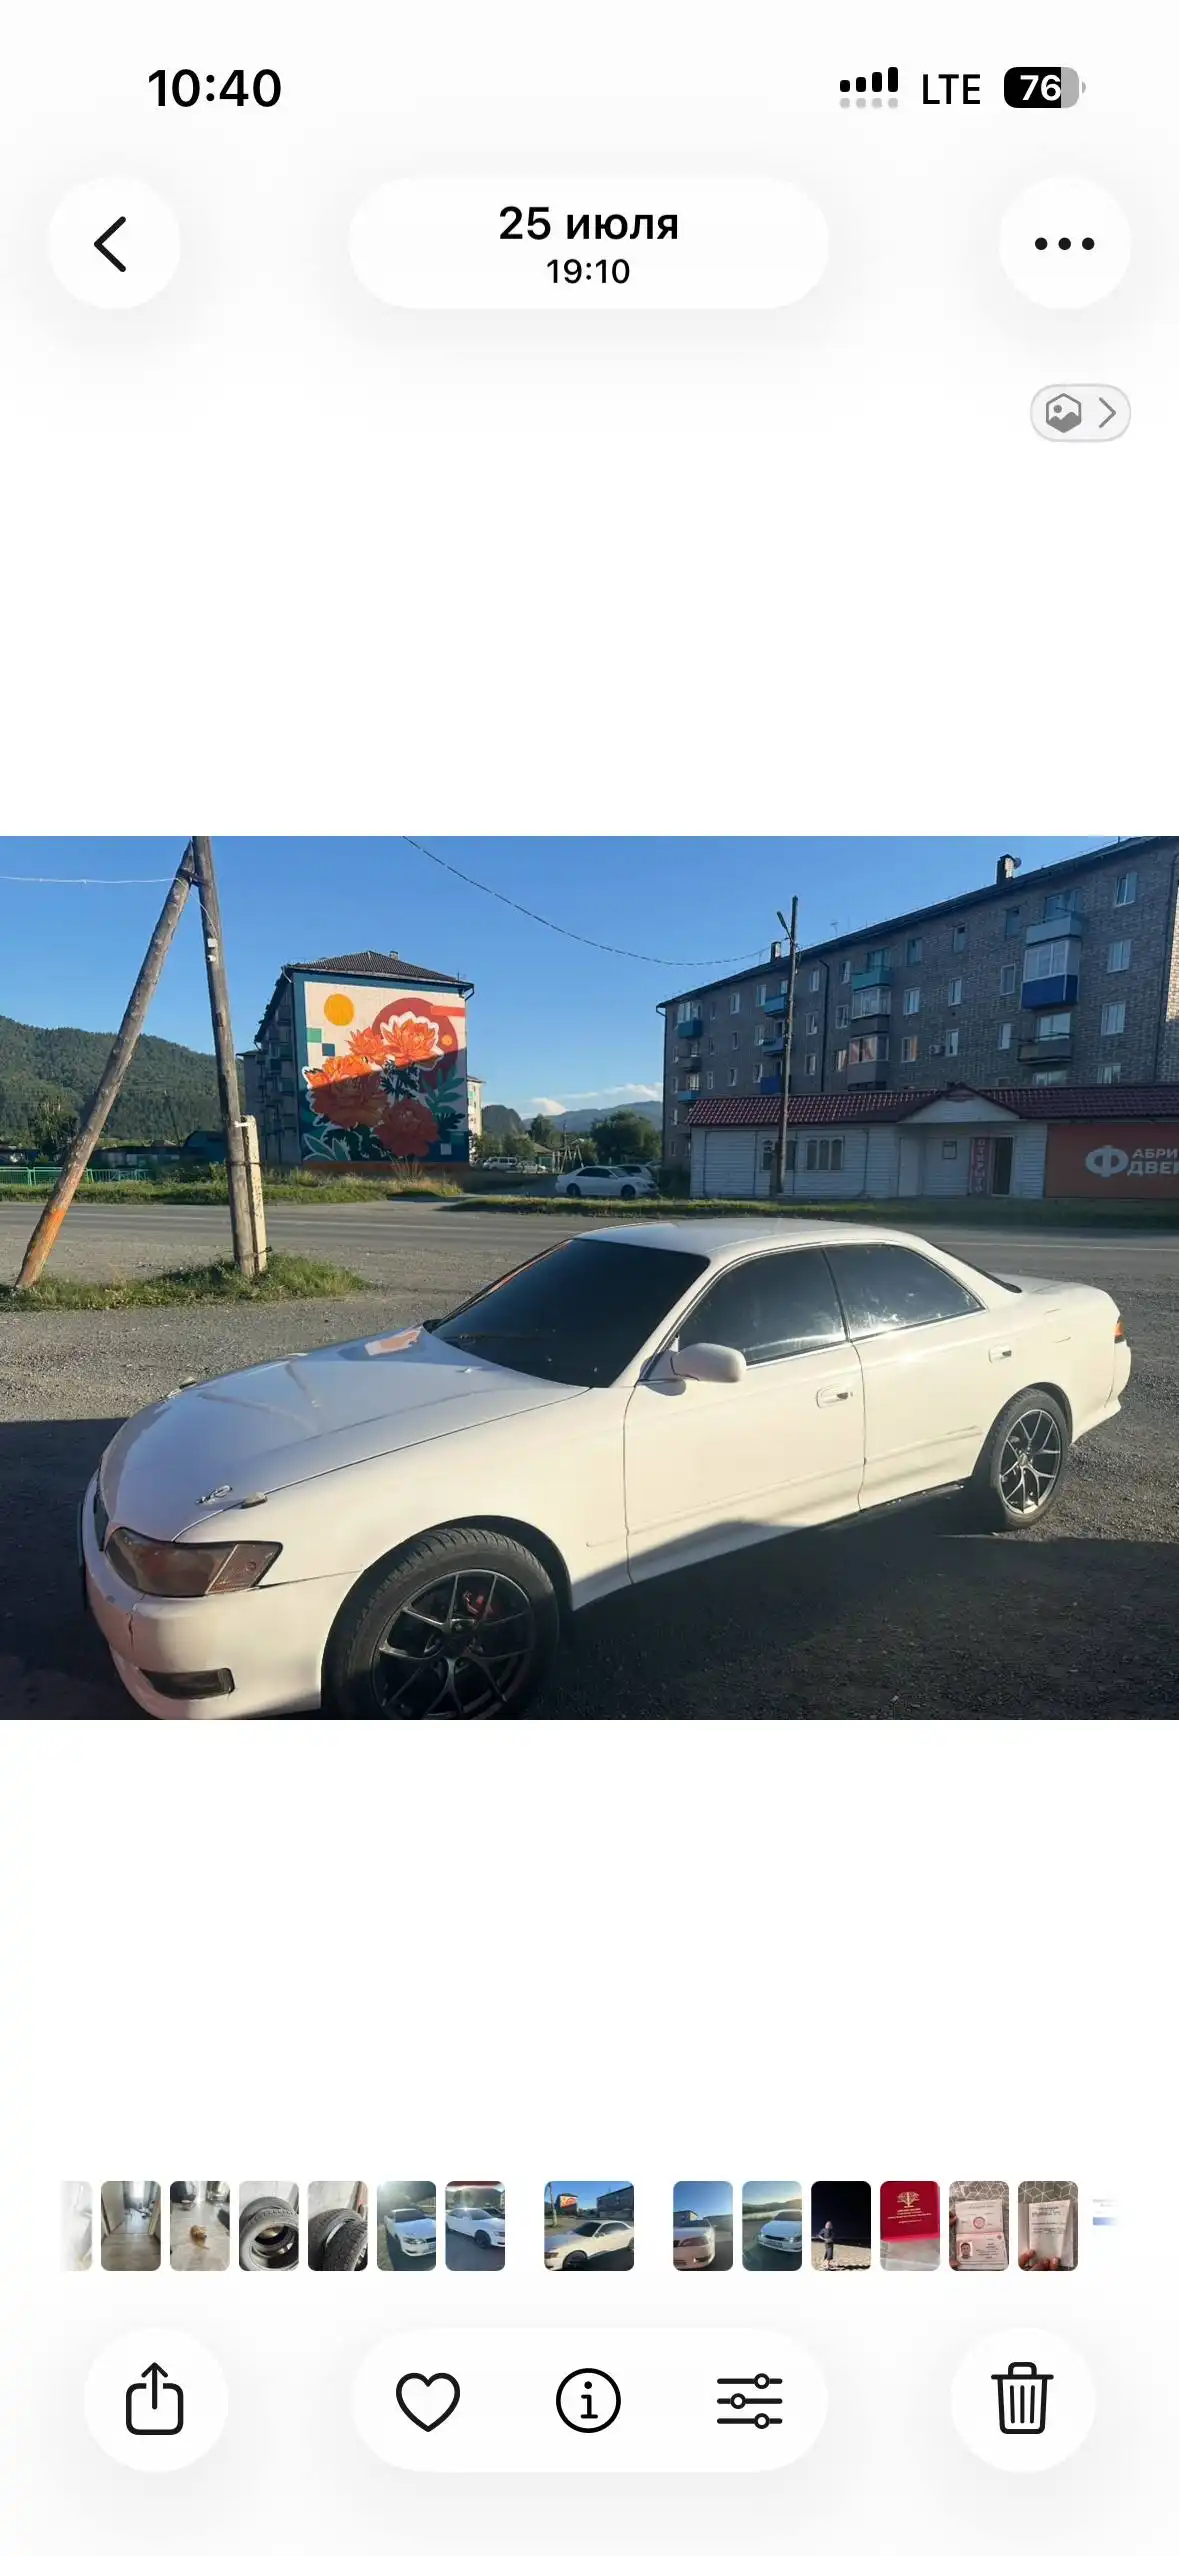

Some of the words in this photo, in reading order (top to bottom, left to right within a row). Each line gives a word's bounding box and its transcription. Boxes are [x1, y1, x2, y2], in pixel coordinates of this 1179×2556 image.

[148, 68, 282, 108] 10:40
[922, 73, 981, 105] LTE
[1020, 74, 1062, 101] 76
[499, 205, 551, 241] 25
[566, 213, 678, 240] июля
[547, 258, 630, 284] 19:10
